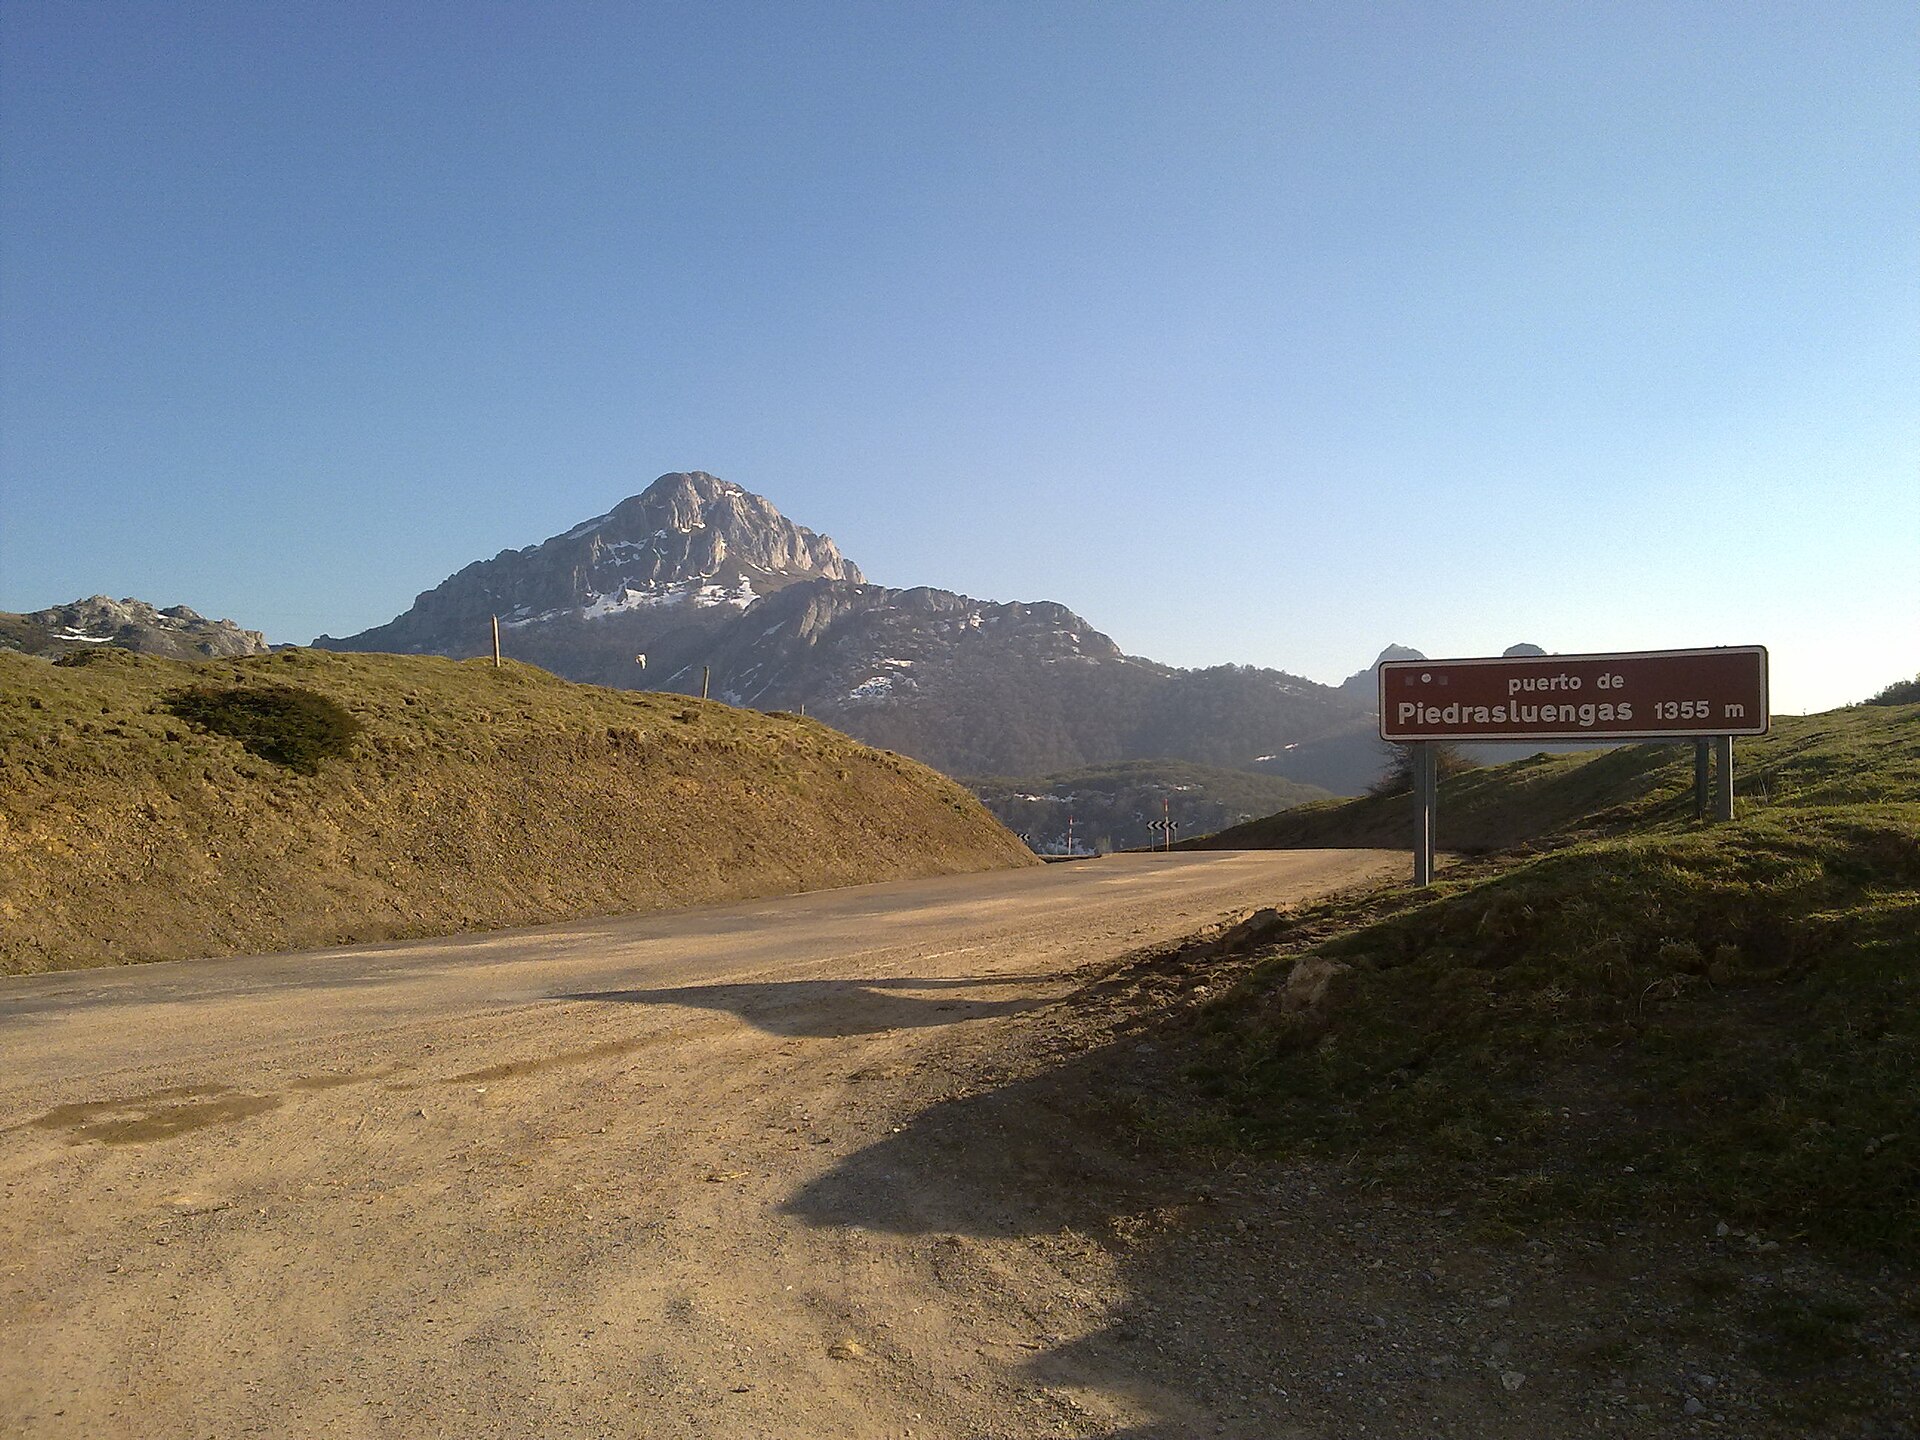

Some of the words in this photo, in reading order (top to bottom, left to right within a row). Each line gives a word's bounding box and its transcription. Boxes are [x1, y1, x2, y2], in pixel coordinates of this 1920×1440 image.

[1508, 675, 1582, 695] puerto
[1597, 672, 1625, 691] de
[1398, 700, 1633, 726] Piedrasluengas
[1654, 701, 1710, 720] 1355
[1724, 703, 1745, 718] m
